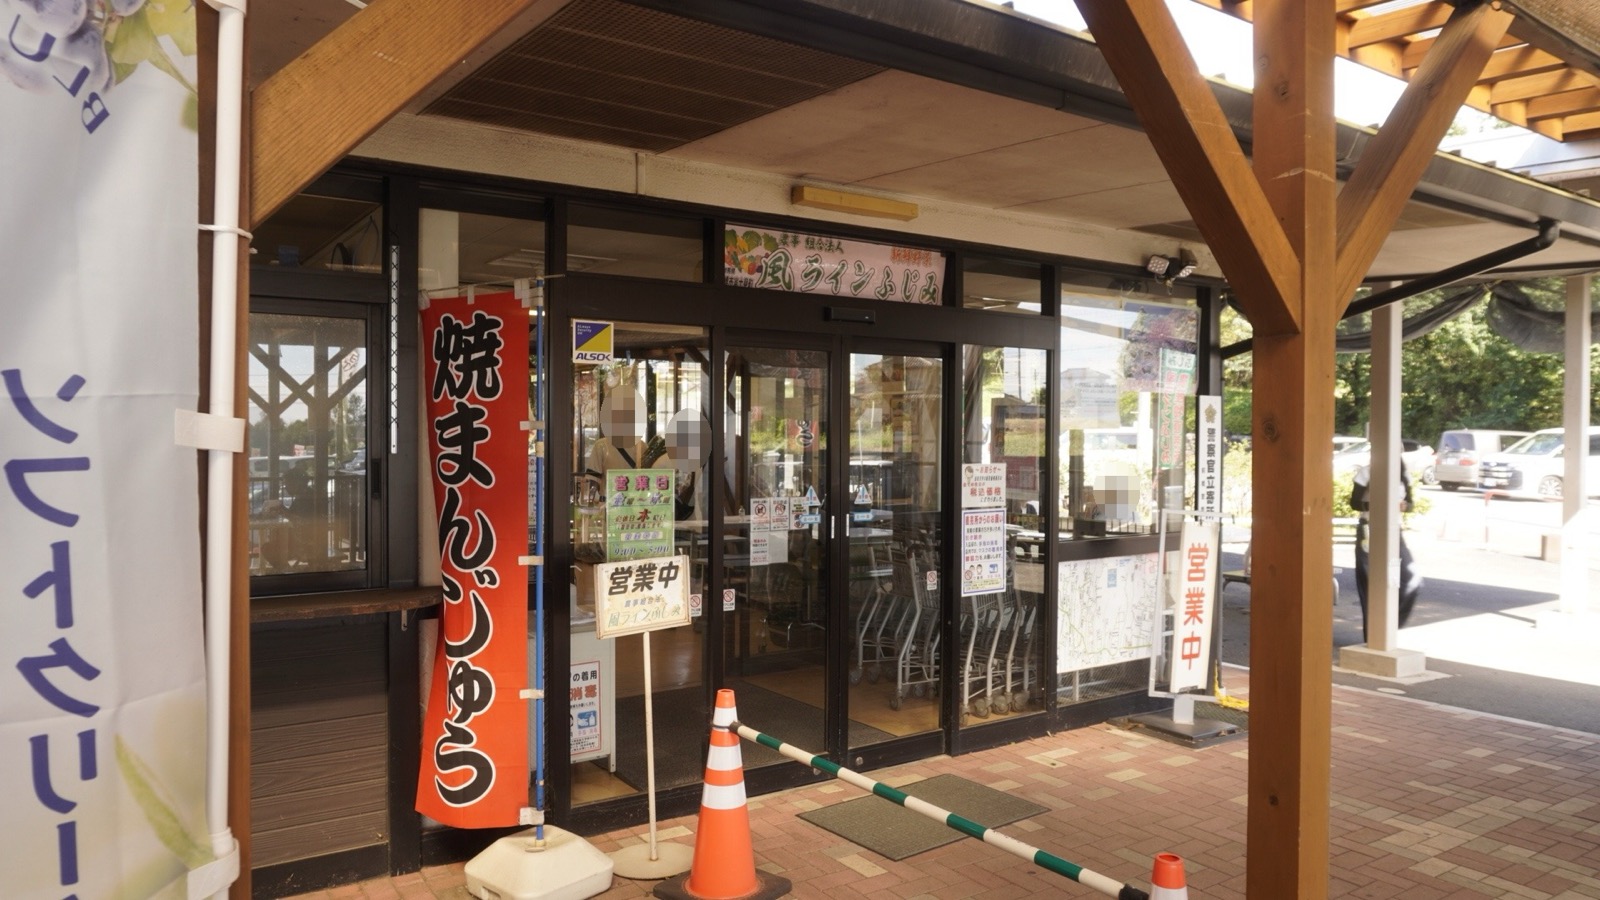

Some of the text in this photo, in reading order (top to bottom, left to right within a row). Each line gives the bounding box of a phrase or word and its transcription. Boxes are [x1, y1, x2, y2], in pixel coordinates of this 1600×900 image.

[756, 247, 940, 305] 風ラインふじみ
[575, 352, 611, 361] ALSOK
[615, 475, 669, 491] 営業日
[970, 486, 1001, 496] 税込価格
[432, 309, 502, 808] 焼まんじゅう
[608, 561, 679, 595] 営業中
[1181, 543, 1209, 670] 営業中
[570, 670, 597, 682] の着用
